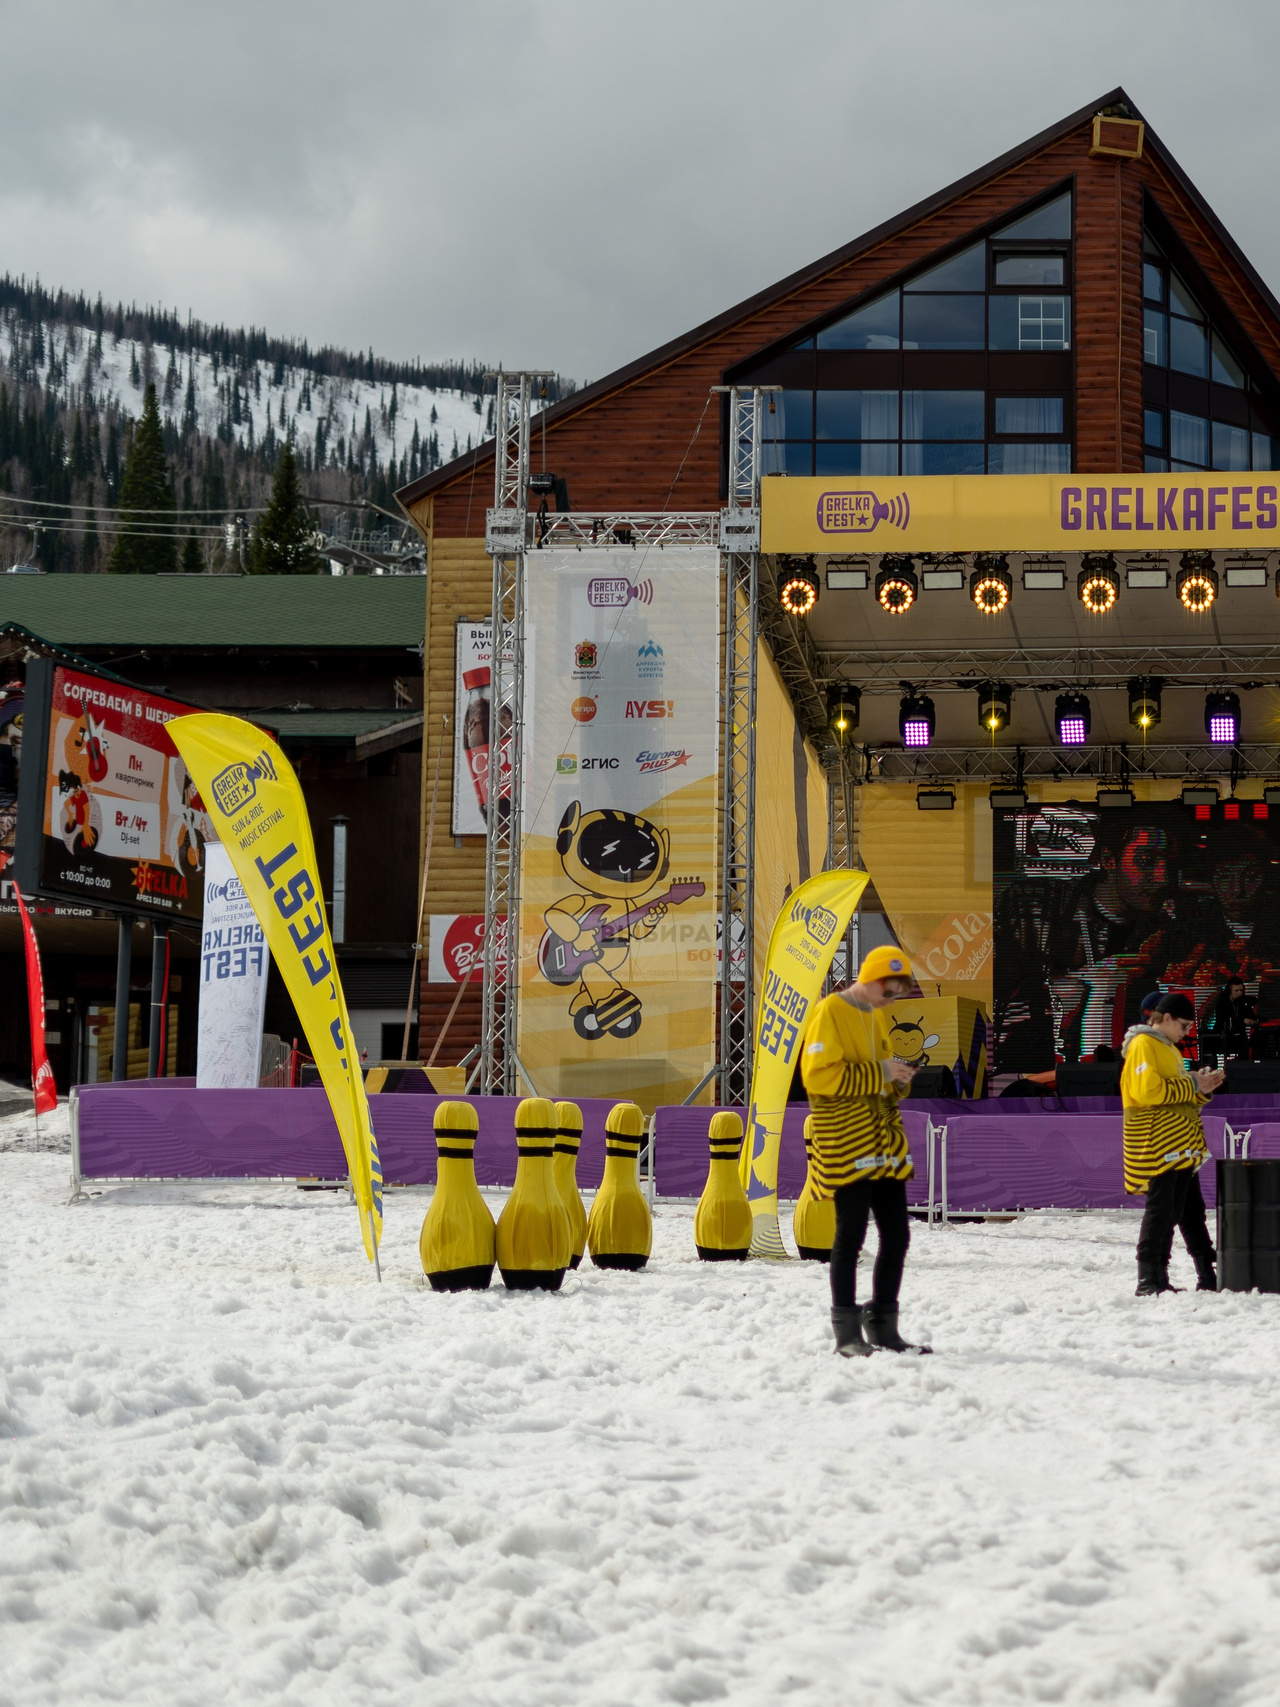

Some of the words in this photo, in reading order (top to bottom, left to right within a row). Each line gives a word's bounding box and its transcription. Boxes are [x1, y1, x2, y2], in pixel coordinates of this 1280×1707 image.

[826, 497, 870, 511] GRELKA
[826, 513, 856, 527] FEST
[594, 581, 625, 592] GRELKA
[594, 593, 615, 603] FEST
[63, 682, 132, 716] СОГРЕВАЕМ
[135, 703, 142, 717] В
[625, 700, 674, 719] AYS!
[128, 755, 144, 772] Пн.
[581, 758, 620, 769] 2ГИС
[635, 750, 682, 763] Europa
[115, 772, 154, 789] квартирник
[216, 767, 244, 796] GRELKA
[223, 786, 243, 810] FEST
[231, 819, 246, 835] SUN
[244, 815, 251, 825] &
[248, 803, 265, 822] RIDE
[239, 832, 260, 851] MUSIC
[257, 808, 285, 835] FESTIVAL
[121, 832, 140, 845] Dj-set
[66, 872, 84, 883] 10:00
[85, 875, 94, 886] до
[95, 877, 110, 888] 0:00
[136, 866, 188, 900] GRELKA
[54, 907, 93, 917] ВКУСНО
[926, 913, 986, 977] Cola
